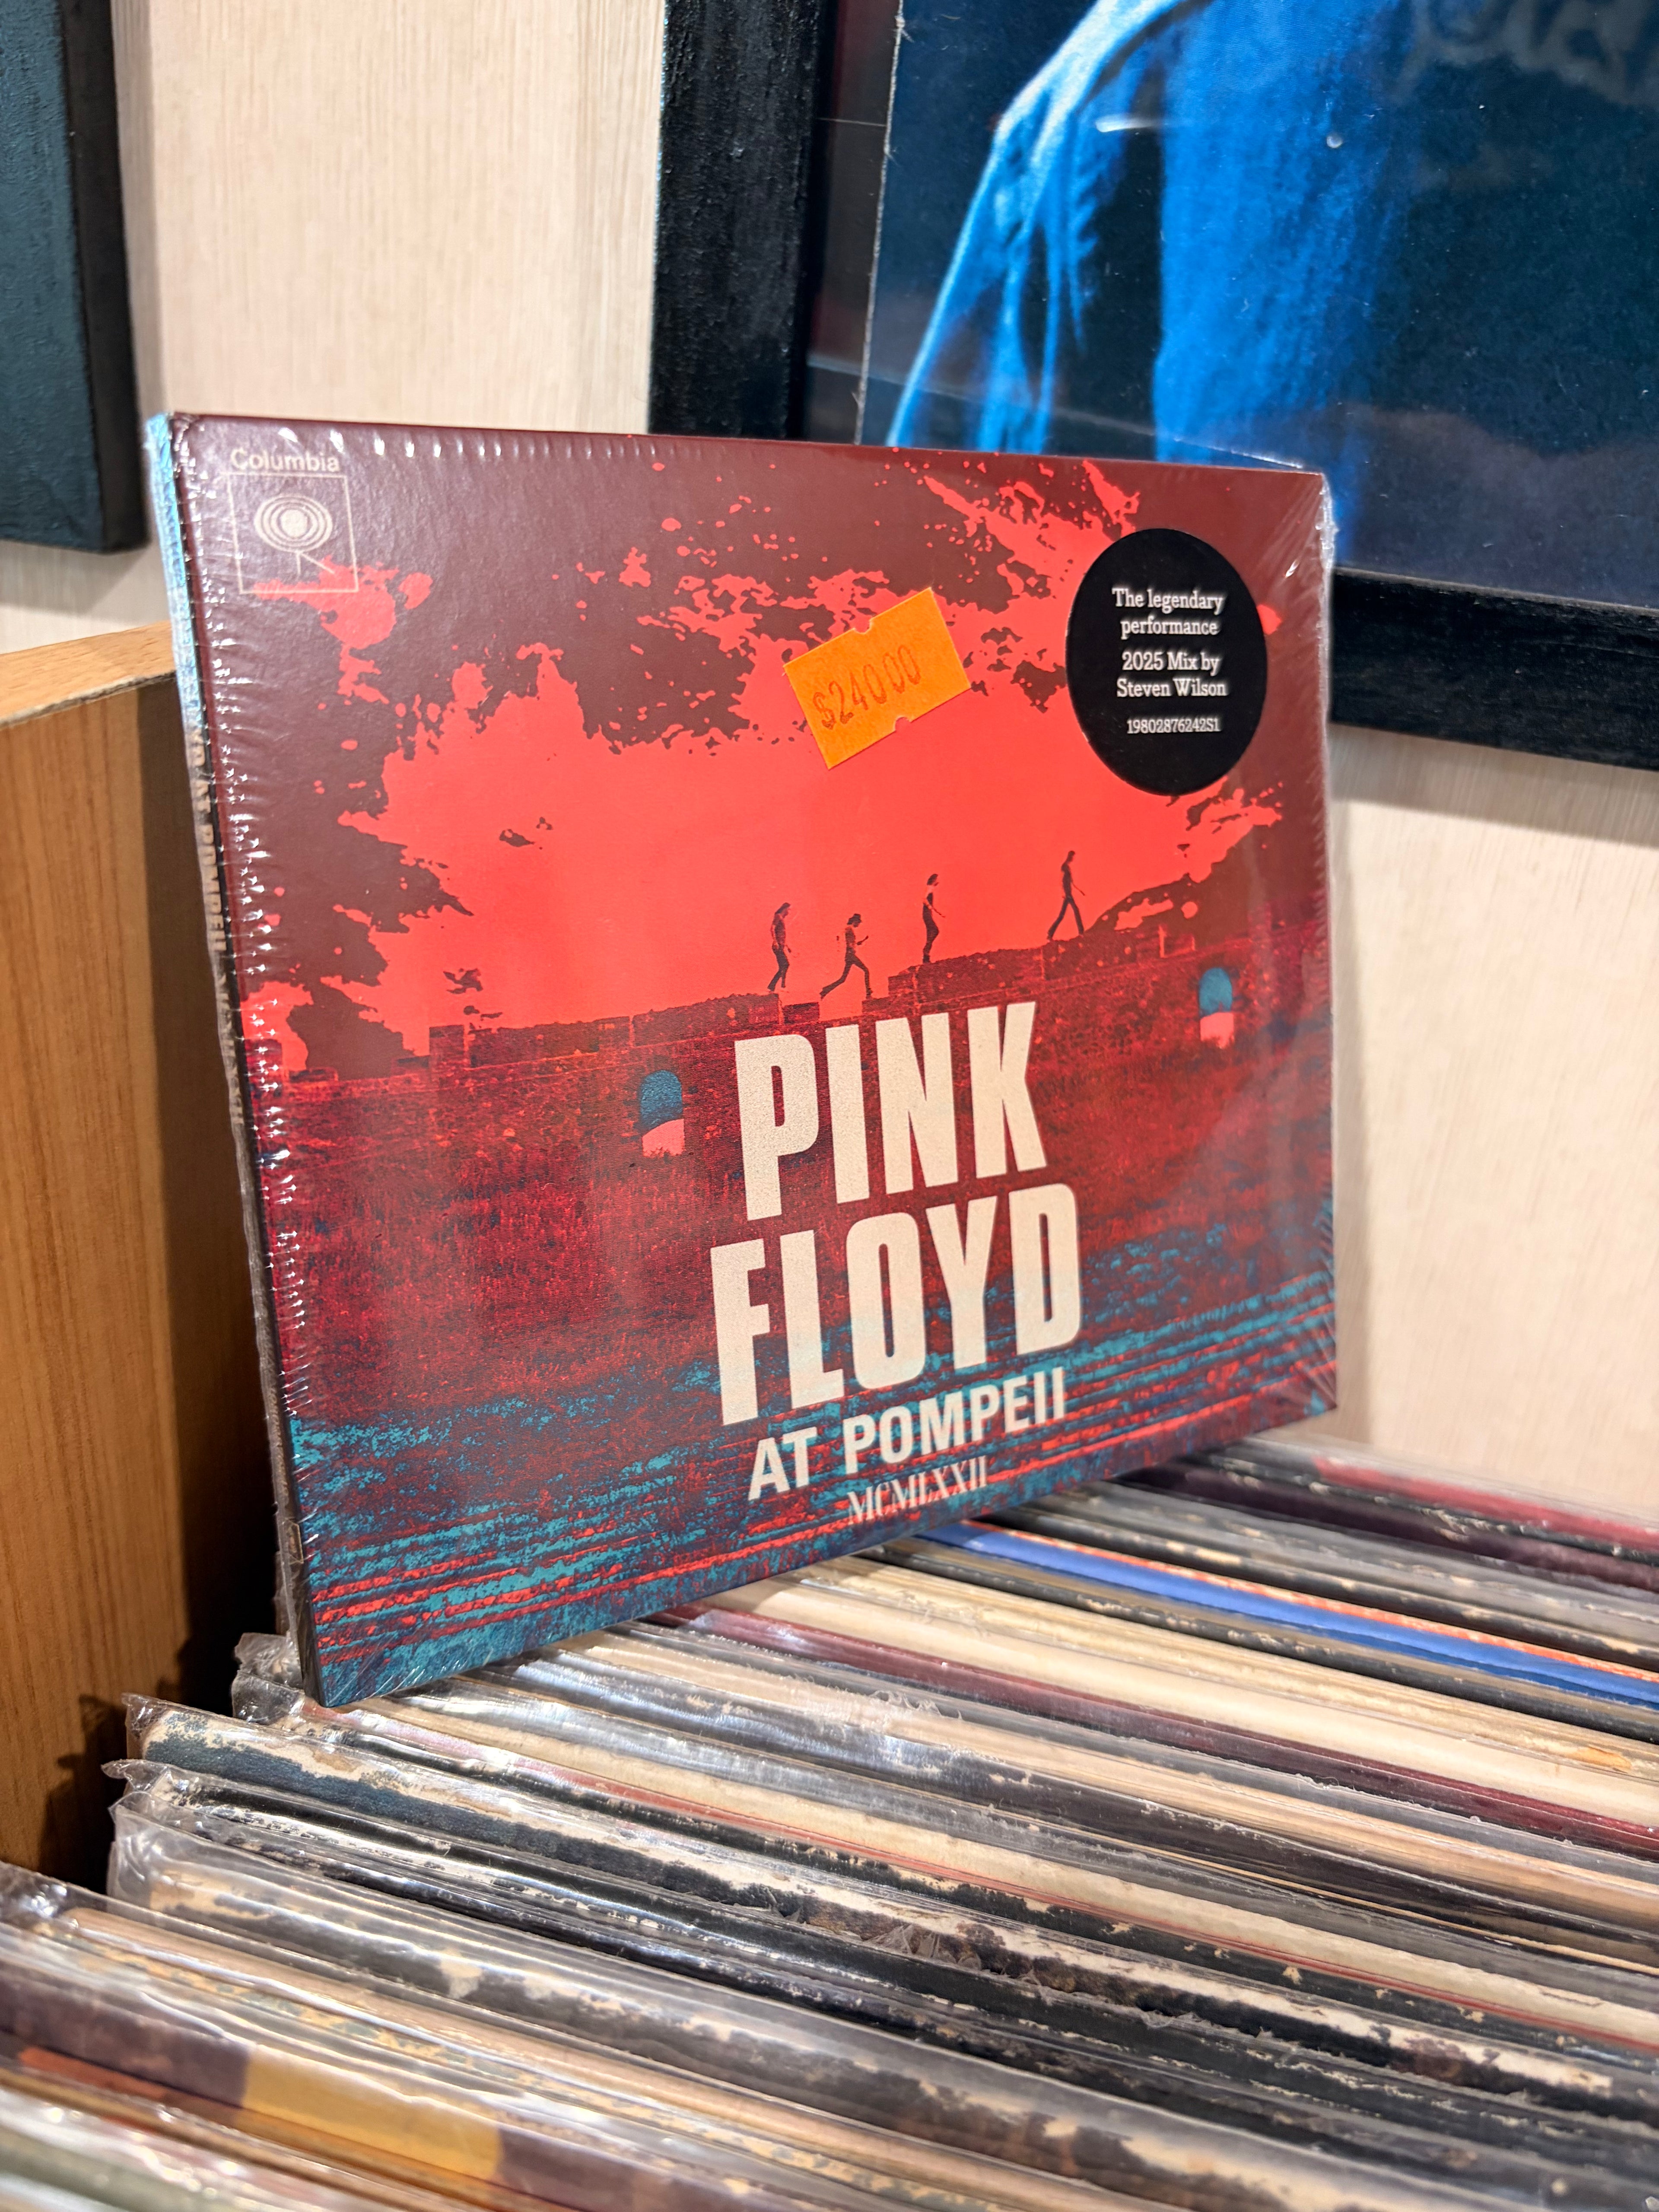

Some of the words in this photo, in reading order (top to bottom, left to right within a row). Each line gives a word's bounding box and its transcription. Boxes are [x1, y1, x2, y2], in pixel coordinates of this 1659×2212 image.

[231, 447, 340, 472] Columbia
[1112, 588, 1145, 607] The
[1147, 588, 1224, 615] legendary
[1120, 615, 1220, 640] performance
[1122, 651, 1165, 671] 2025
[1167, 651, 1199, 671] Mix
[1200, 652, 1220, 677] by
[1116, 677, 1173, 697] Steven
[1173, 677, 1229, 697] Wilson
[734, 1001, 1048, 1221] PINK
[709, 1182, 1082, 1426] FLOYD
[747, 1427, 820, 1501] AT
[842, 1367, 1066, 1476] POMPEII
[847, 1455, 987, 1526] MCMLXXII
